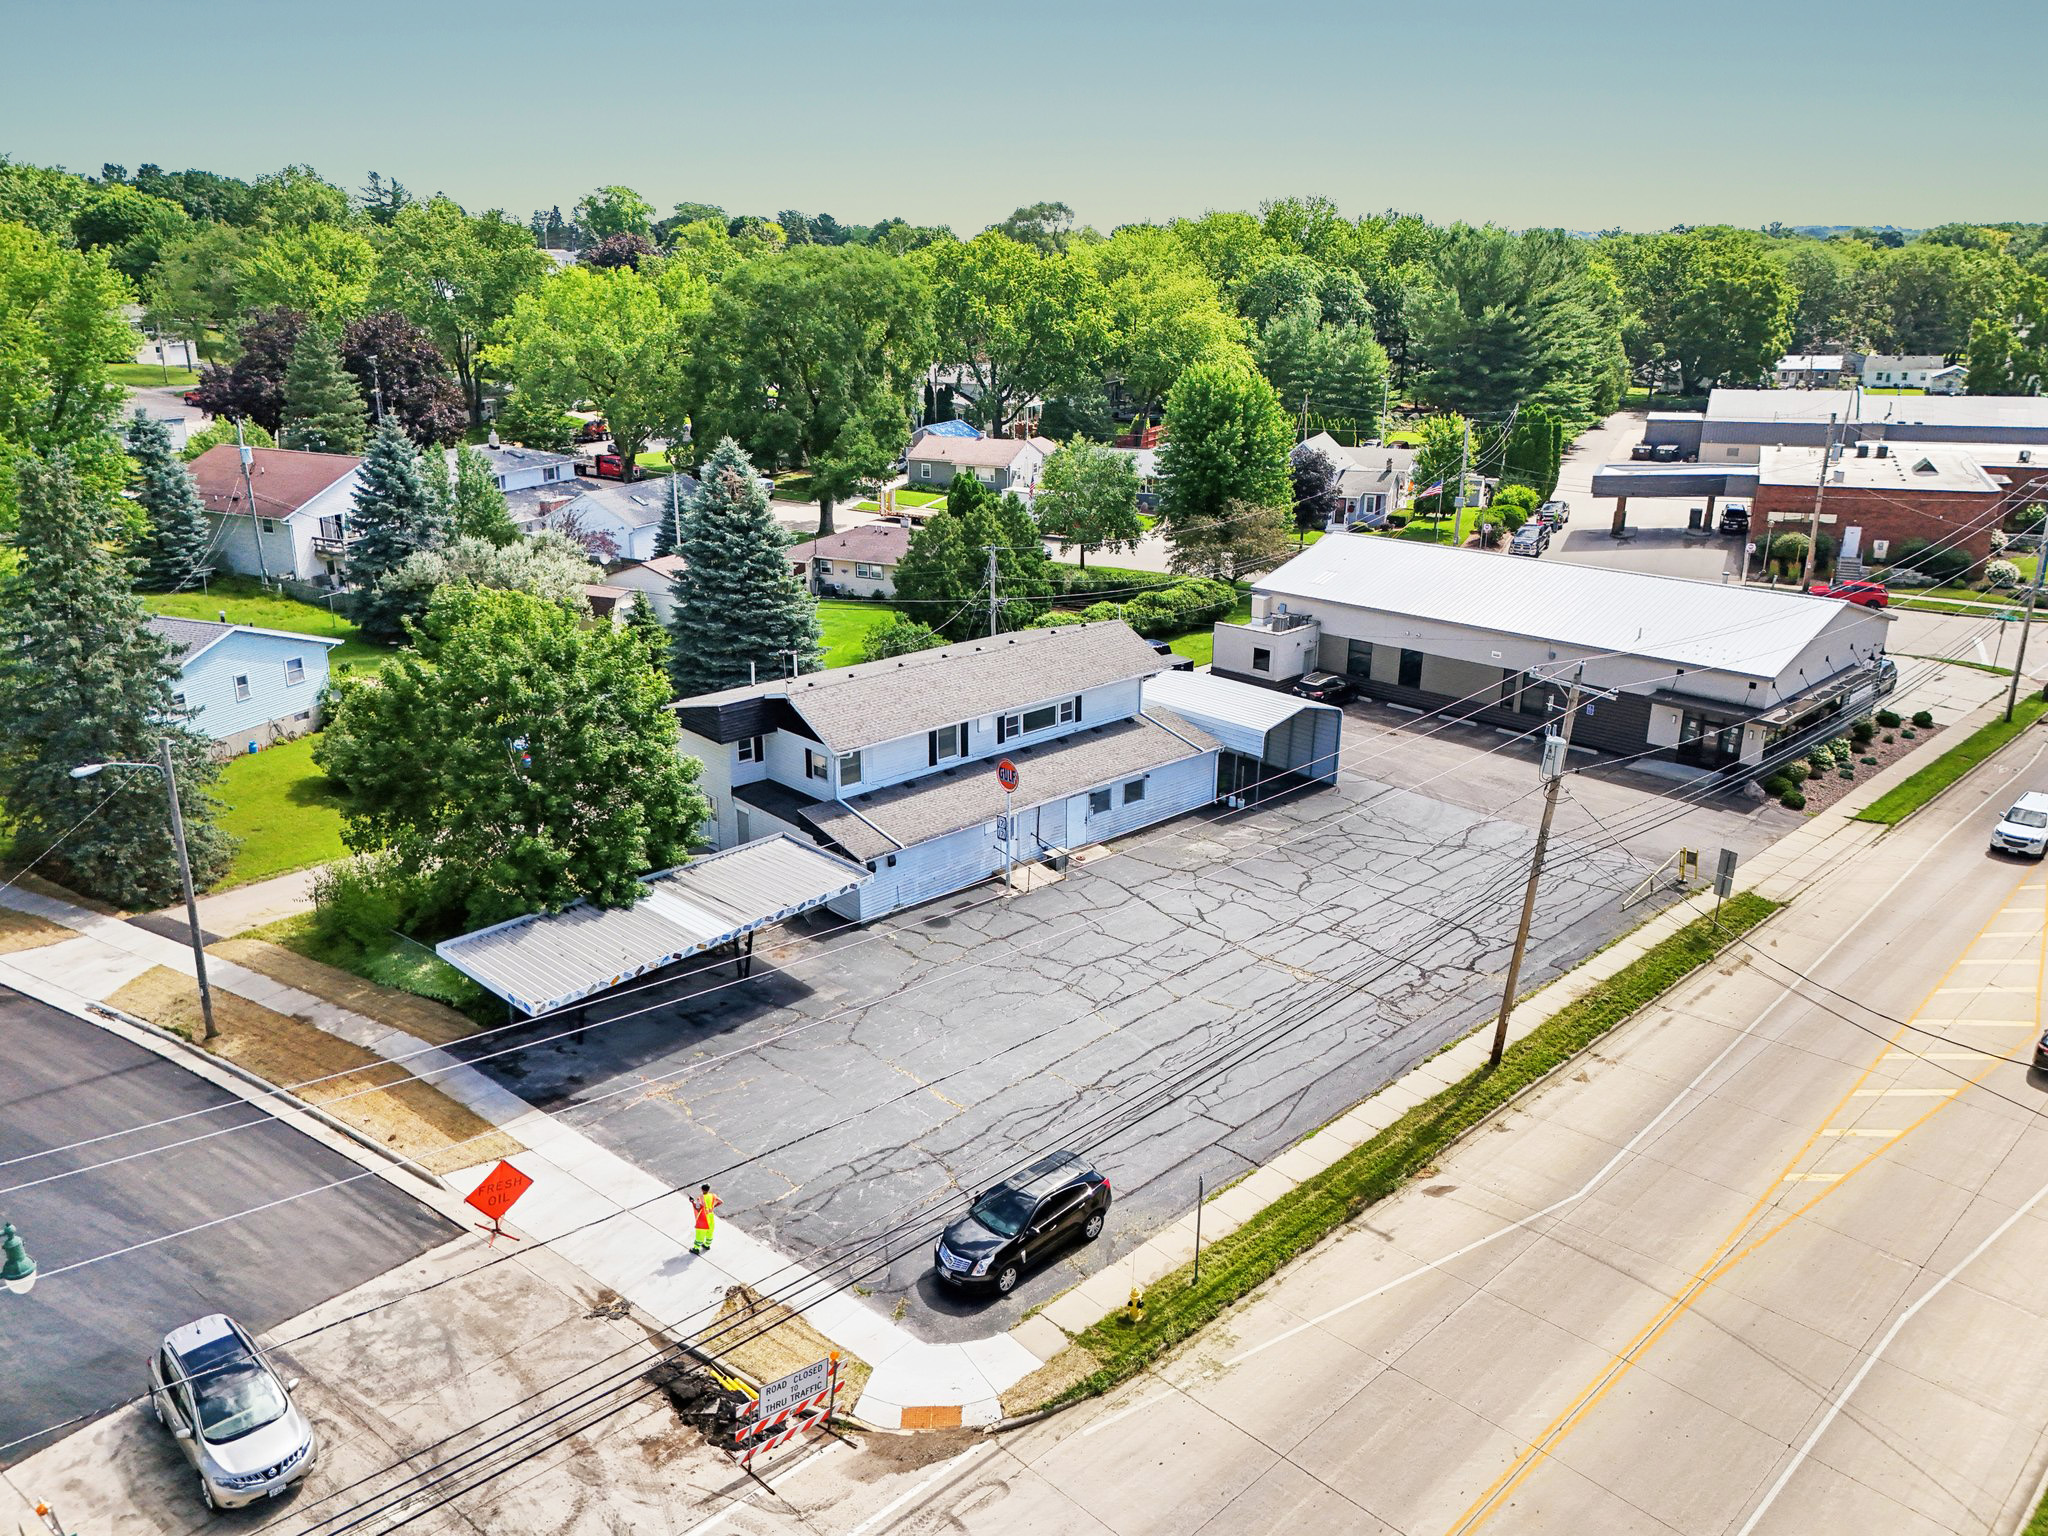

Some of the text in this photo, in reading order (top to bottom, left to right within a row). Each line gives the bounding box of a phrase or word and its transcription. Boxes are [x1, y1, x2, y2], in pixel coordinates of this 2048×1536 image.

[999, 768, 1017, 784] GULF
[478, 1177, 522, 1196] FRESH
[488, 1194, 510, 1206] OIL
[766, 1364, 823, 1396] ROAD CLOSED
[790, 1384, 799, 1393] TO
[765, 1398, 787, 1413] THRU
[790, 1381, 823, 1402] TRAFFIC
